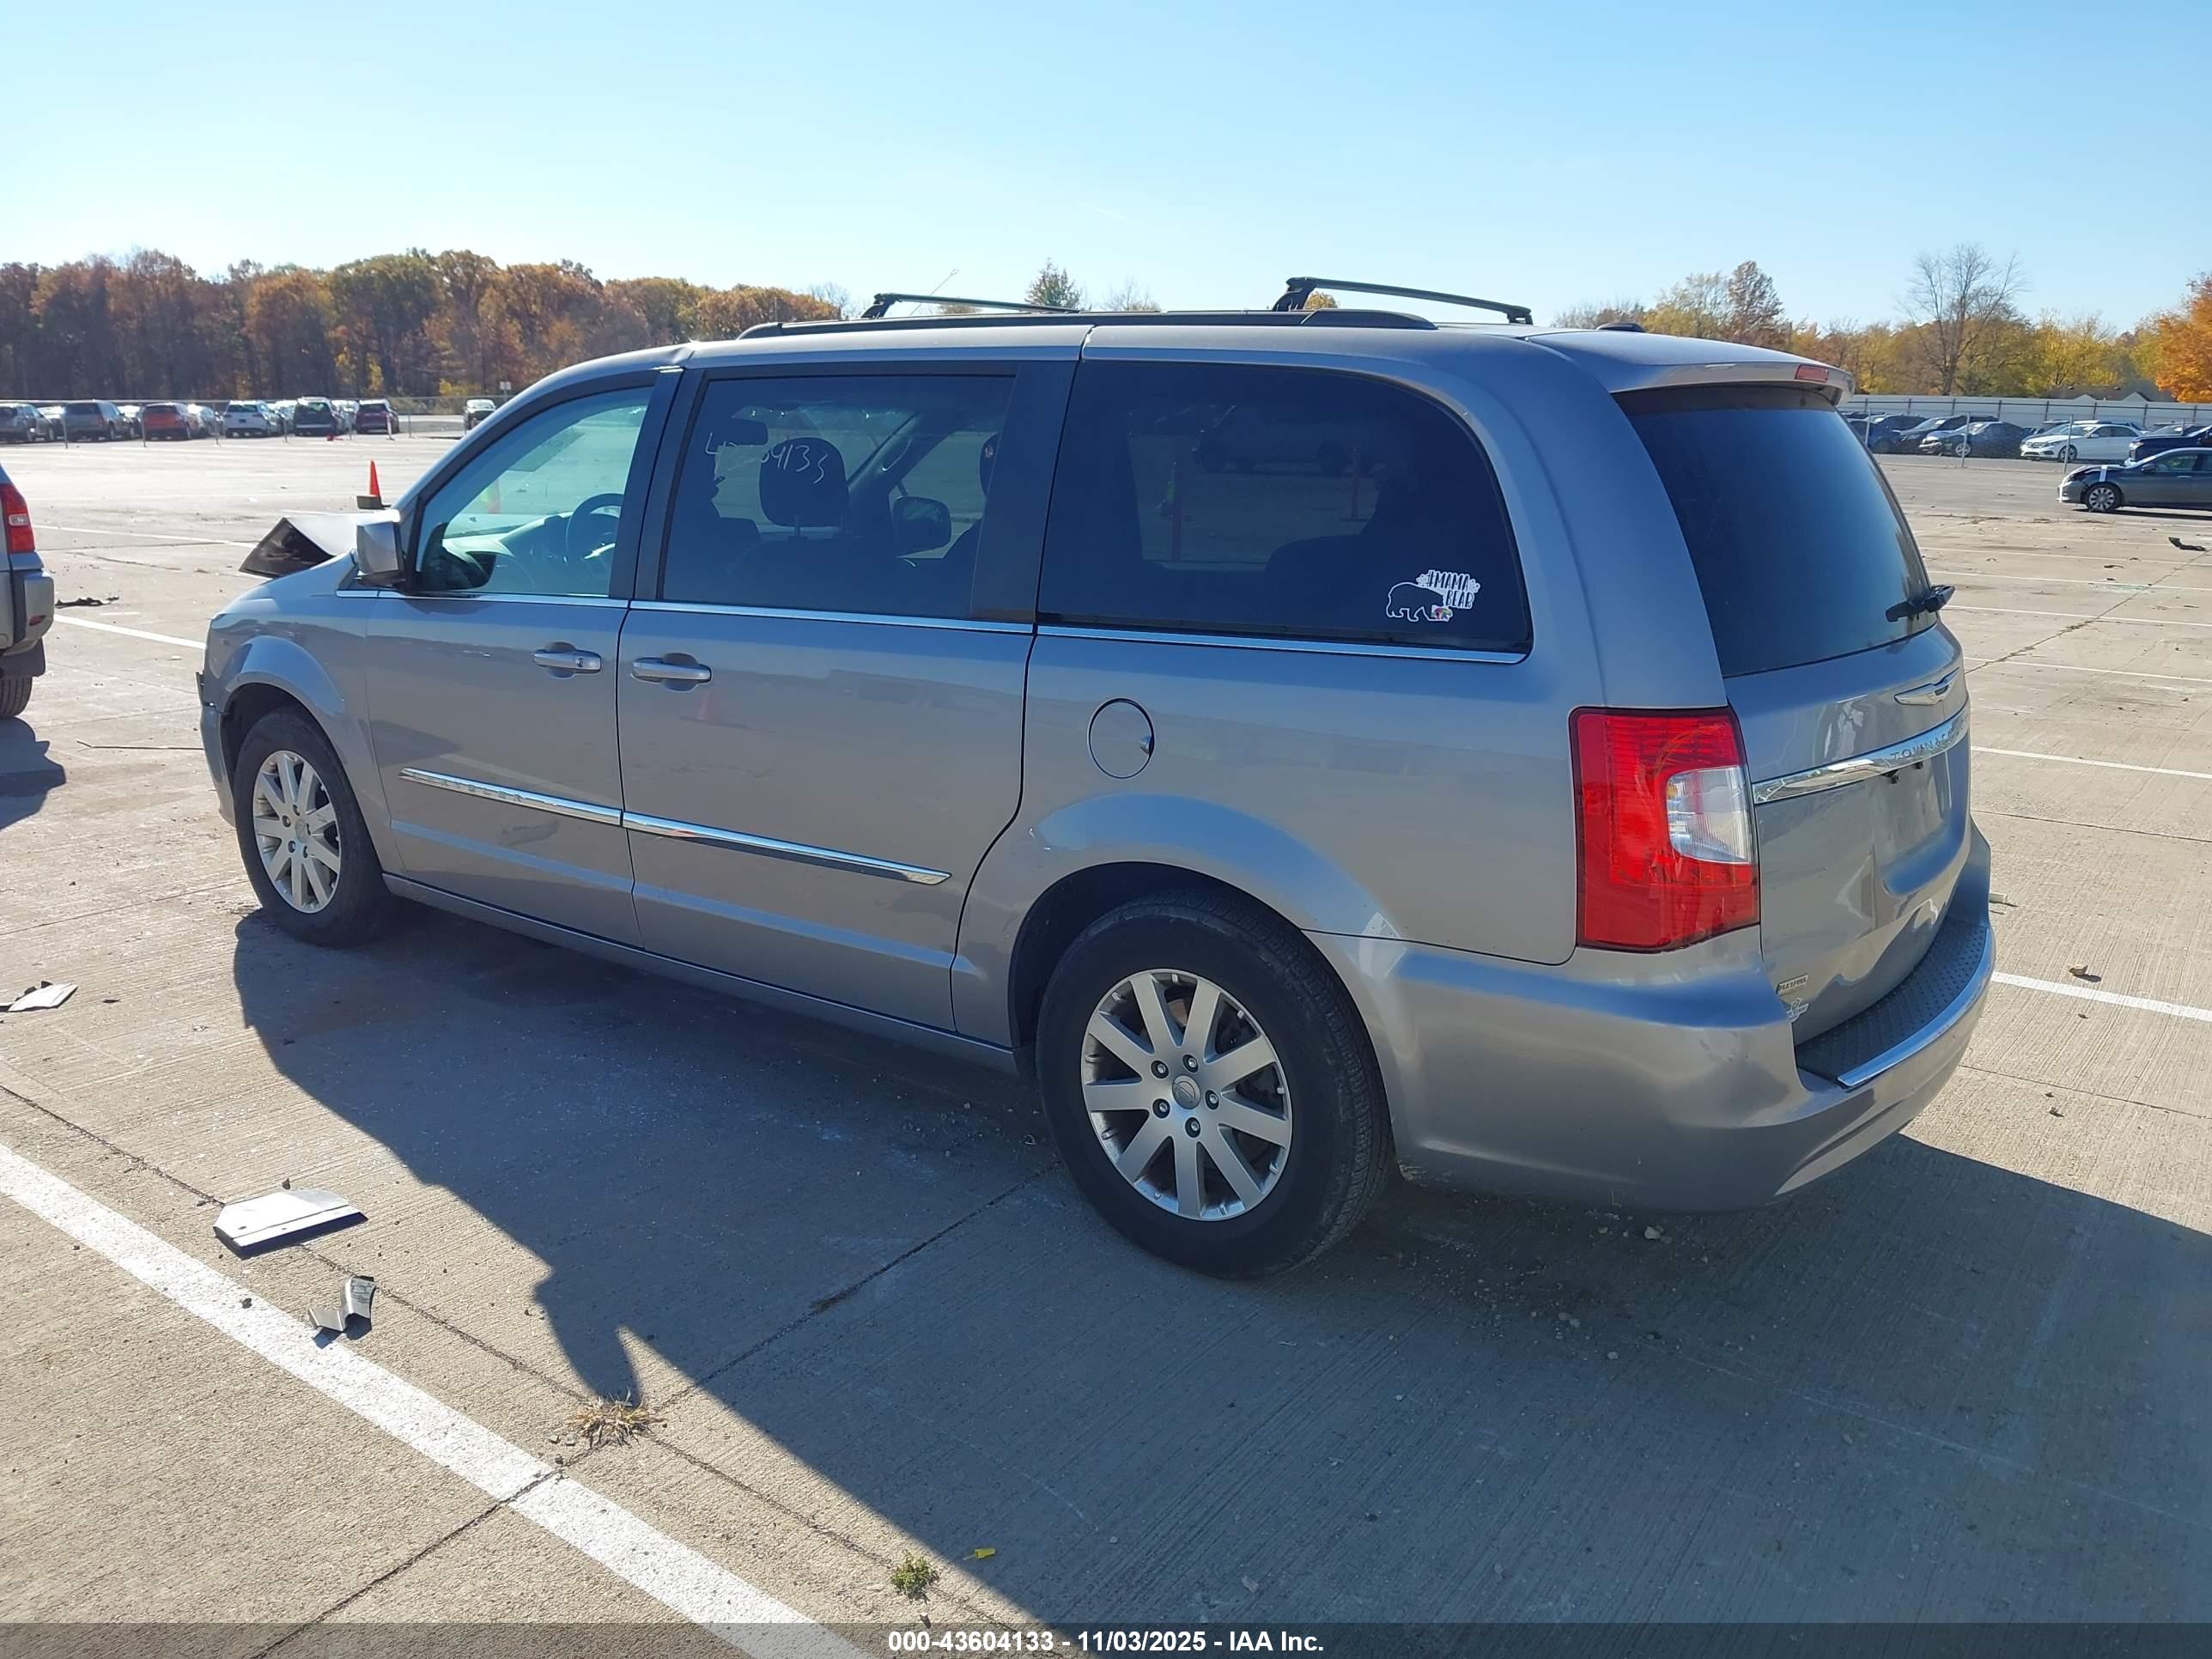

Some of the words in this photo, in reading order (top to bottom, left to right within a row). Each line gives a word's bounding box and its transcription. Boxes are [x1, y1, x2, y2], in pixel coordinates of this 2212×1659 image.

[1425, 570, 1469, 592] #MAMA
[1445, 590, 1474, 609] BEAR
[1889, 741, 1934, 761] TOWN
